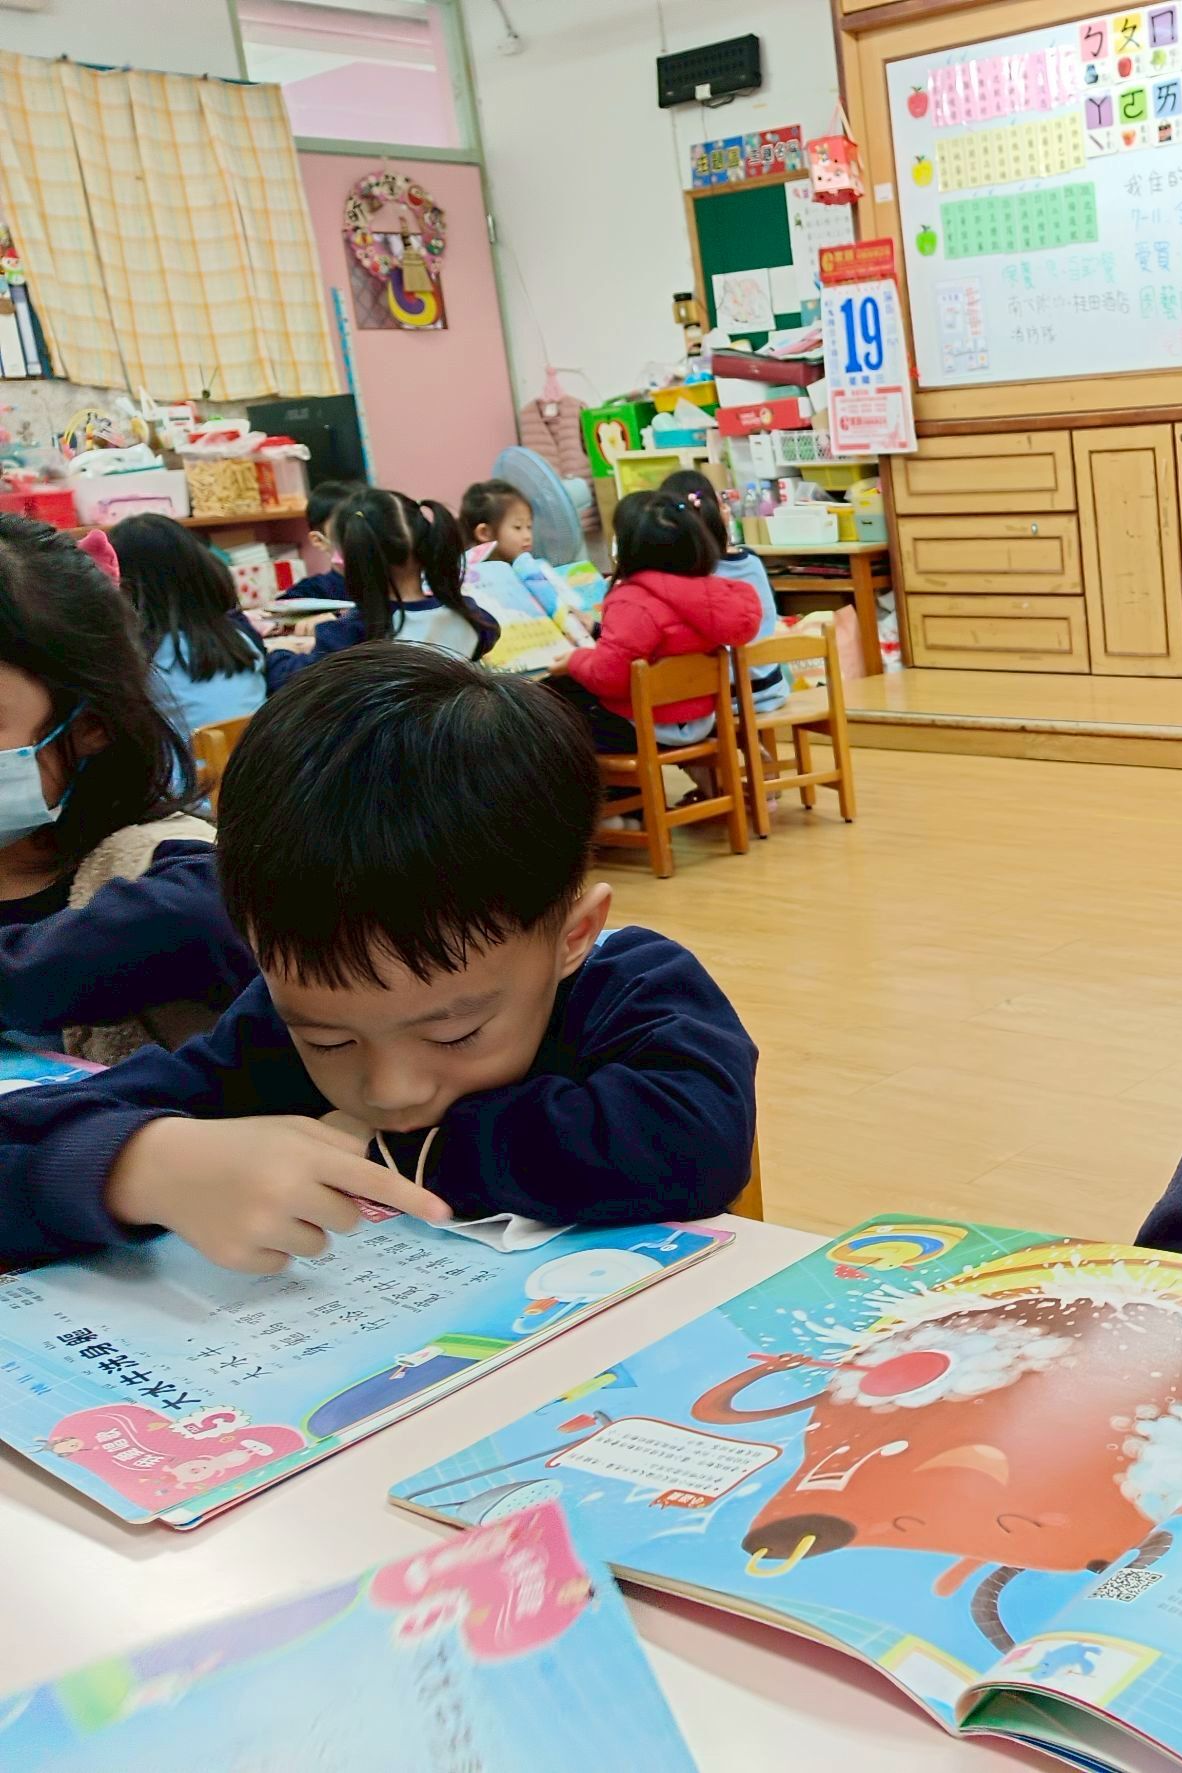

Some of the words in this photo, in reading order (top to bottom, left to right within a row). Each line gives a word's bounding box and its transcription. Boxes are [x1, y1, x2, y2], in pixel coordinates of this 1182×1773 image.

[1084, 26, 1104, 57] ㄅ
[1120, 19, 1142, 51] ㄆ
[1150, 10, 1175, 43] ㄇ
[1088, 97, 1109, 125] ㄚ
[1121, 89, 1144, 119] ㄛ
[1156, 81, 1178, 114] ㄞ
[840, 296, 883, 374] 19
[55, 1324, 202, 1408] 大水牛洗身軀
